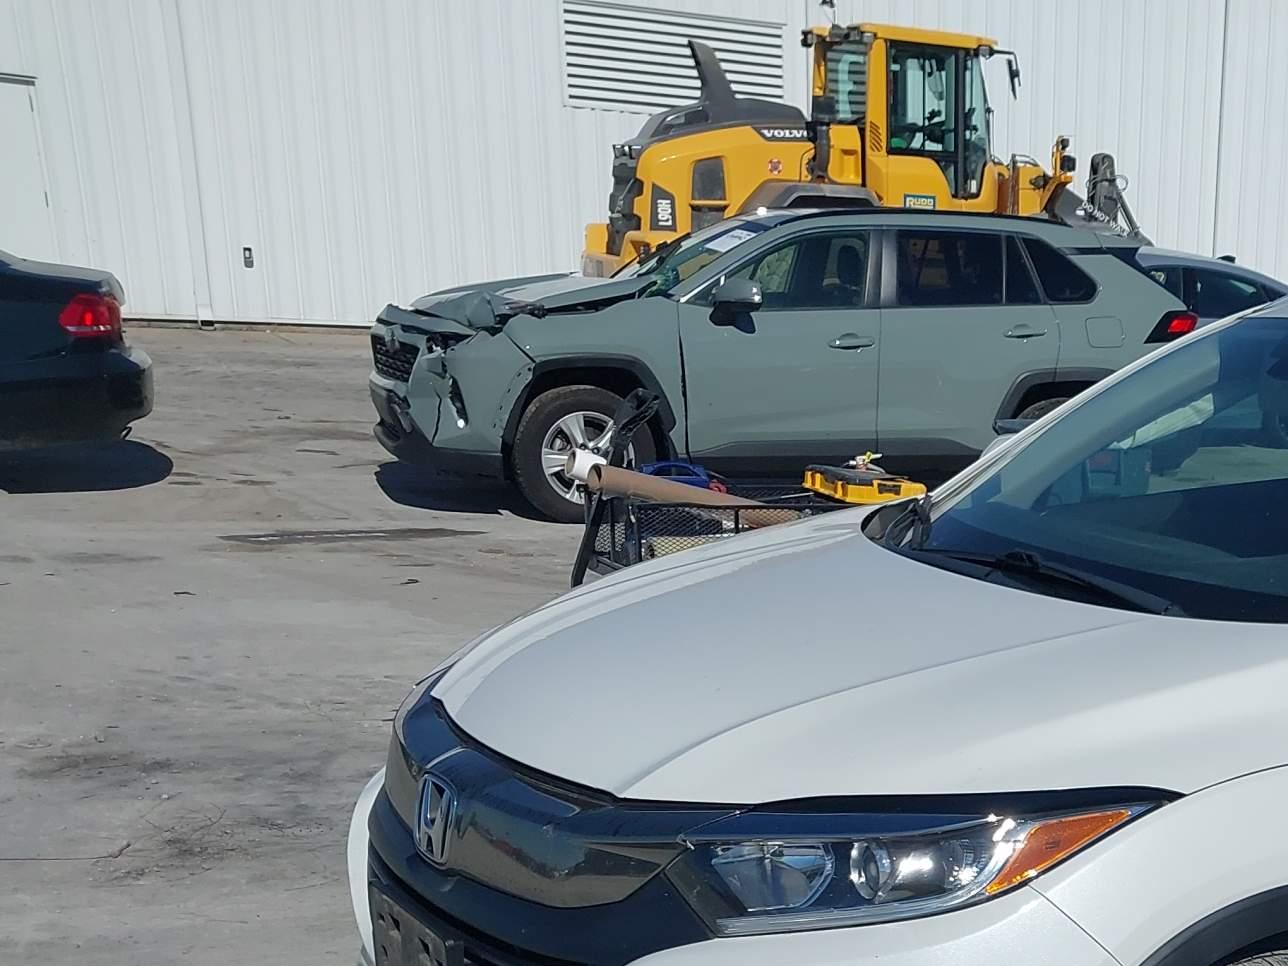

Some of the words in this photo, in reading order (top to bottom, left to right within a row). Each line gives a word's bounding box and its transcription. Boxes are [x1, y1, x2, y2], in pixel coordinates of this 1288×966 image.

[656, 199, 673, 226] L90H
[1082, 201, 1094, 213] DO
[1092, 209, 1110, 223] NOT
